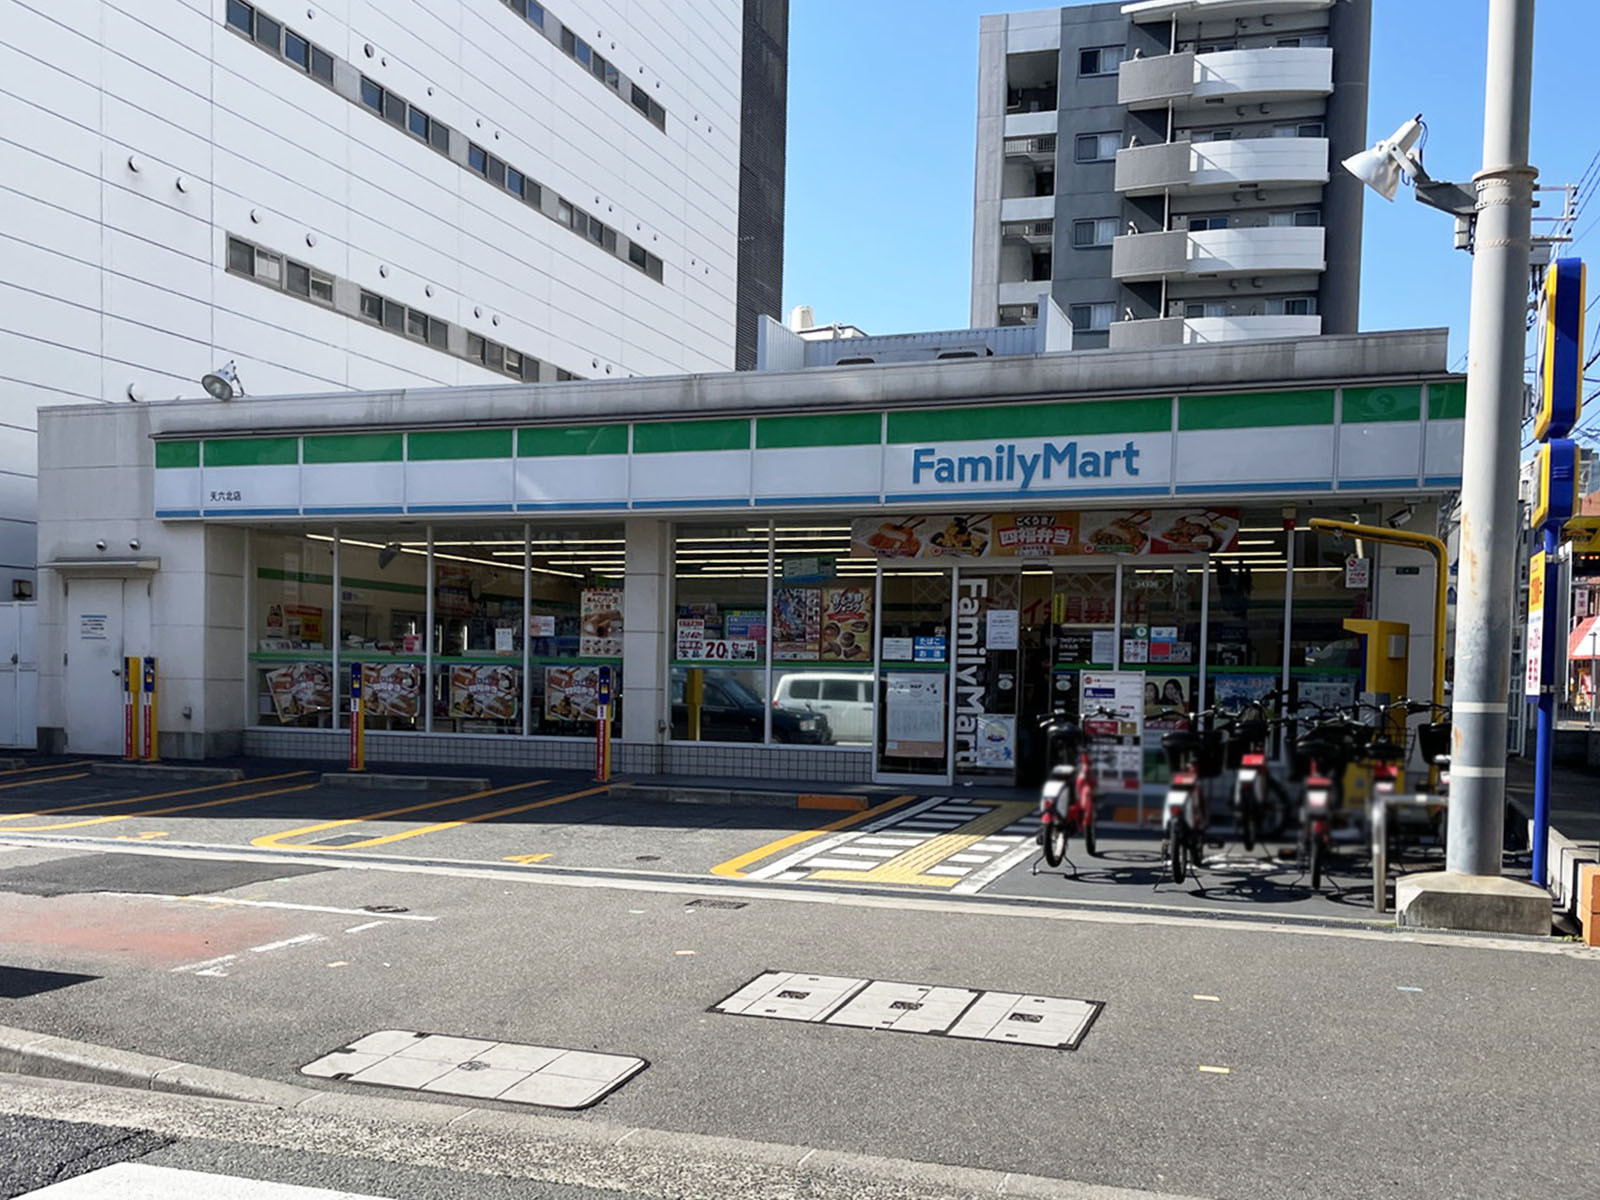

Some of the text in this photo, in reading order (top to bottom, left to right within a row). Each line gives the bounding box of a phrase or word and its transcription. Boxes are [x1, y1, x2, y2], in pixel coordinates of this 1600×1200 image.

[913, 441, 1140, 489] FamilyMart
[210, 491, 241, 502] 天六北店
[956, 578, 988, 768] FamilyMart
